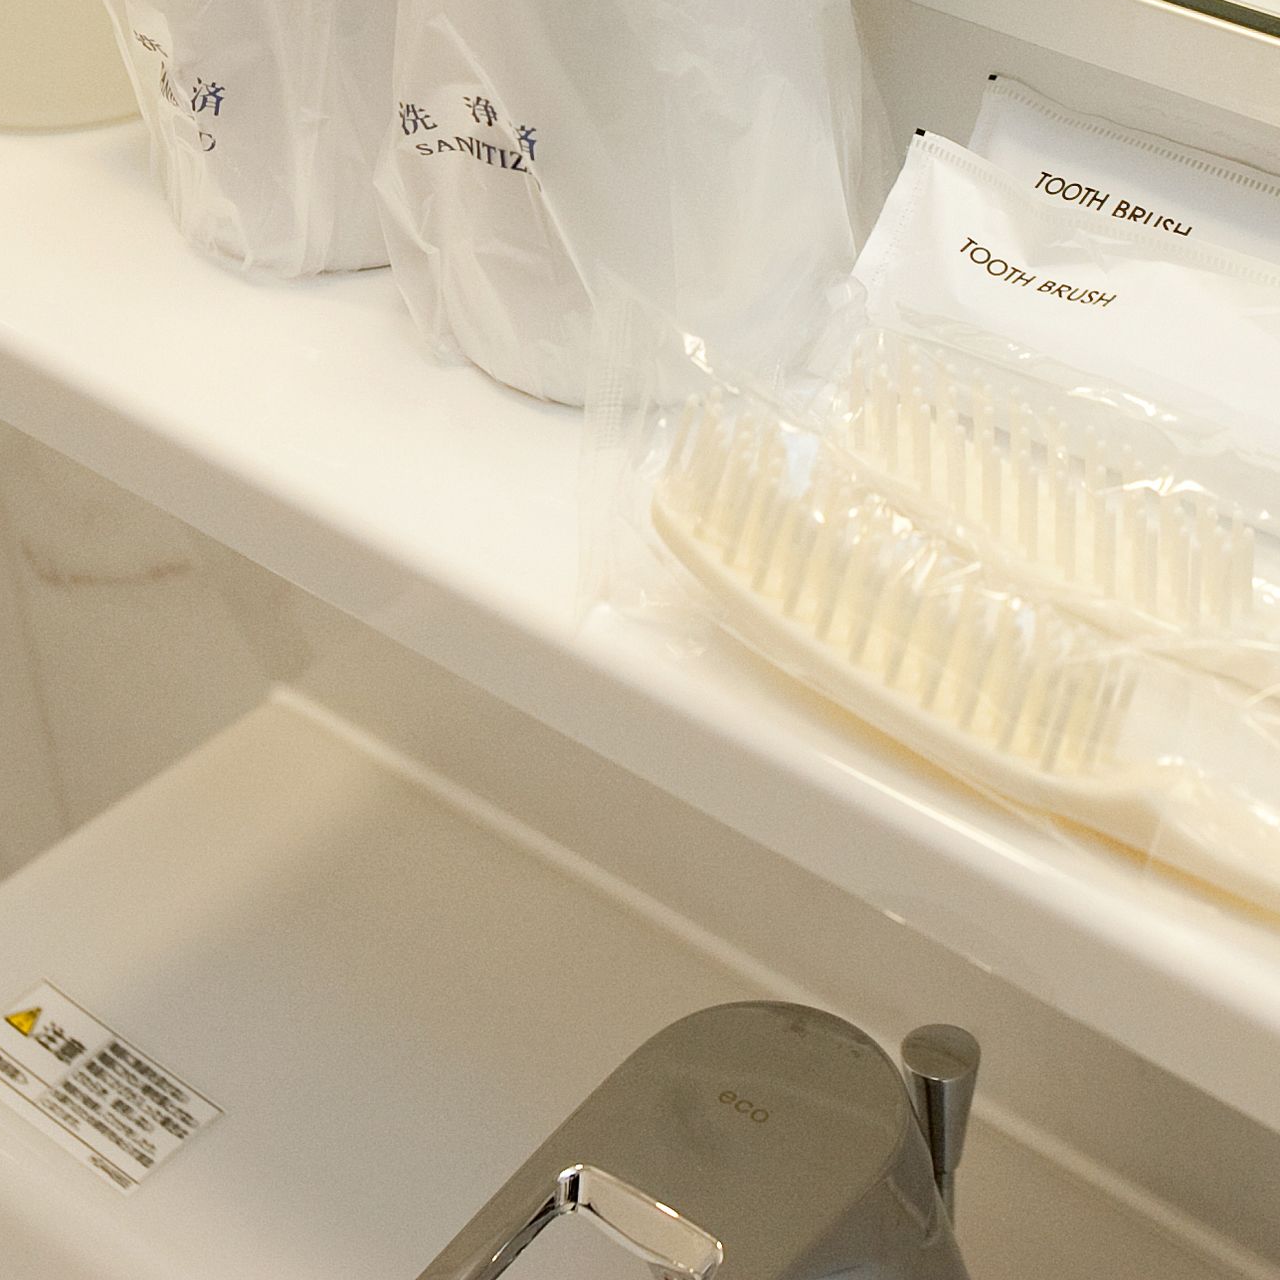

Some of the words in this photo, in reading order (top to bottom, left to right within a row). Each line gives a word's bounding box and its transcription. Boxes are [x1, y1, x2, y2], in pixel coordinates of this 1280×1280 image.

[1034, 172, 1110, 211] TOOTH
[959, 237, 1036, 287] TOOTH
[1037, 280, 1117, 308] BRUSH
[719, 1090, 769, 1123] eco
